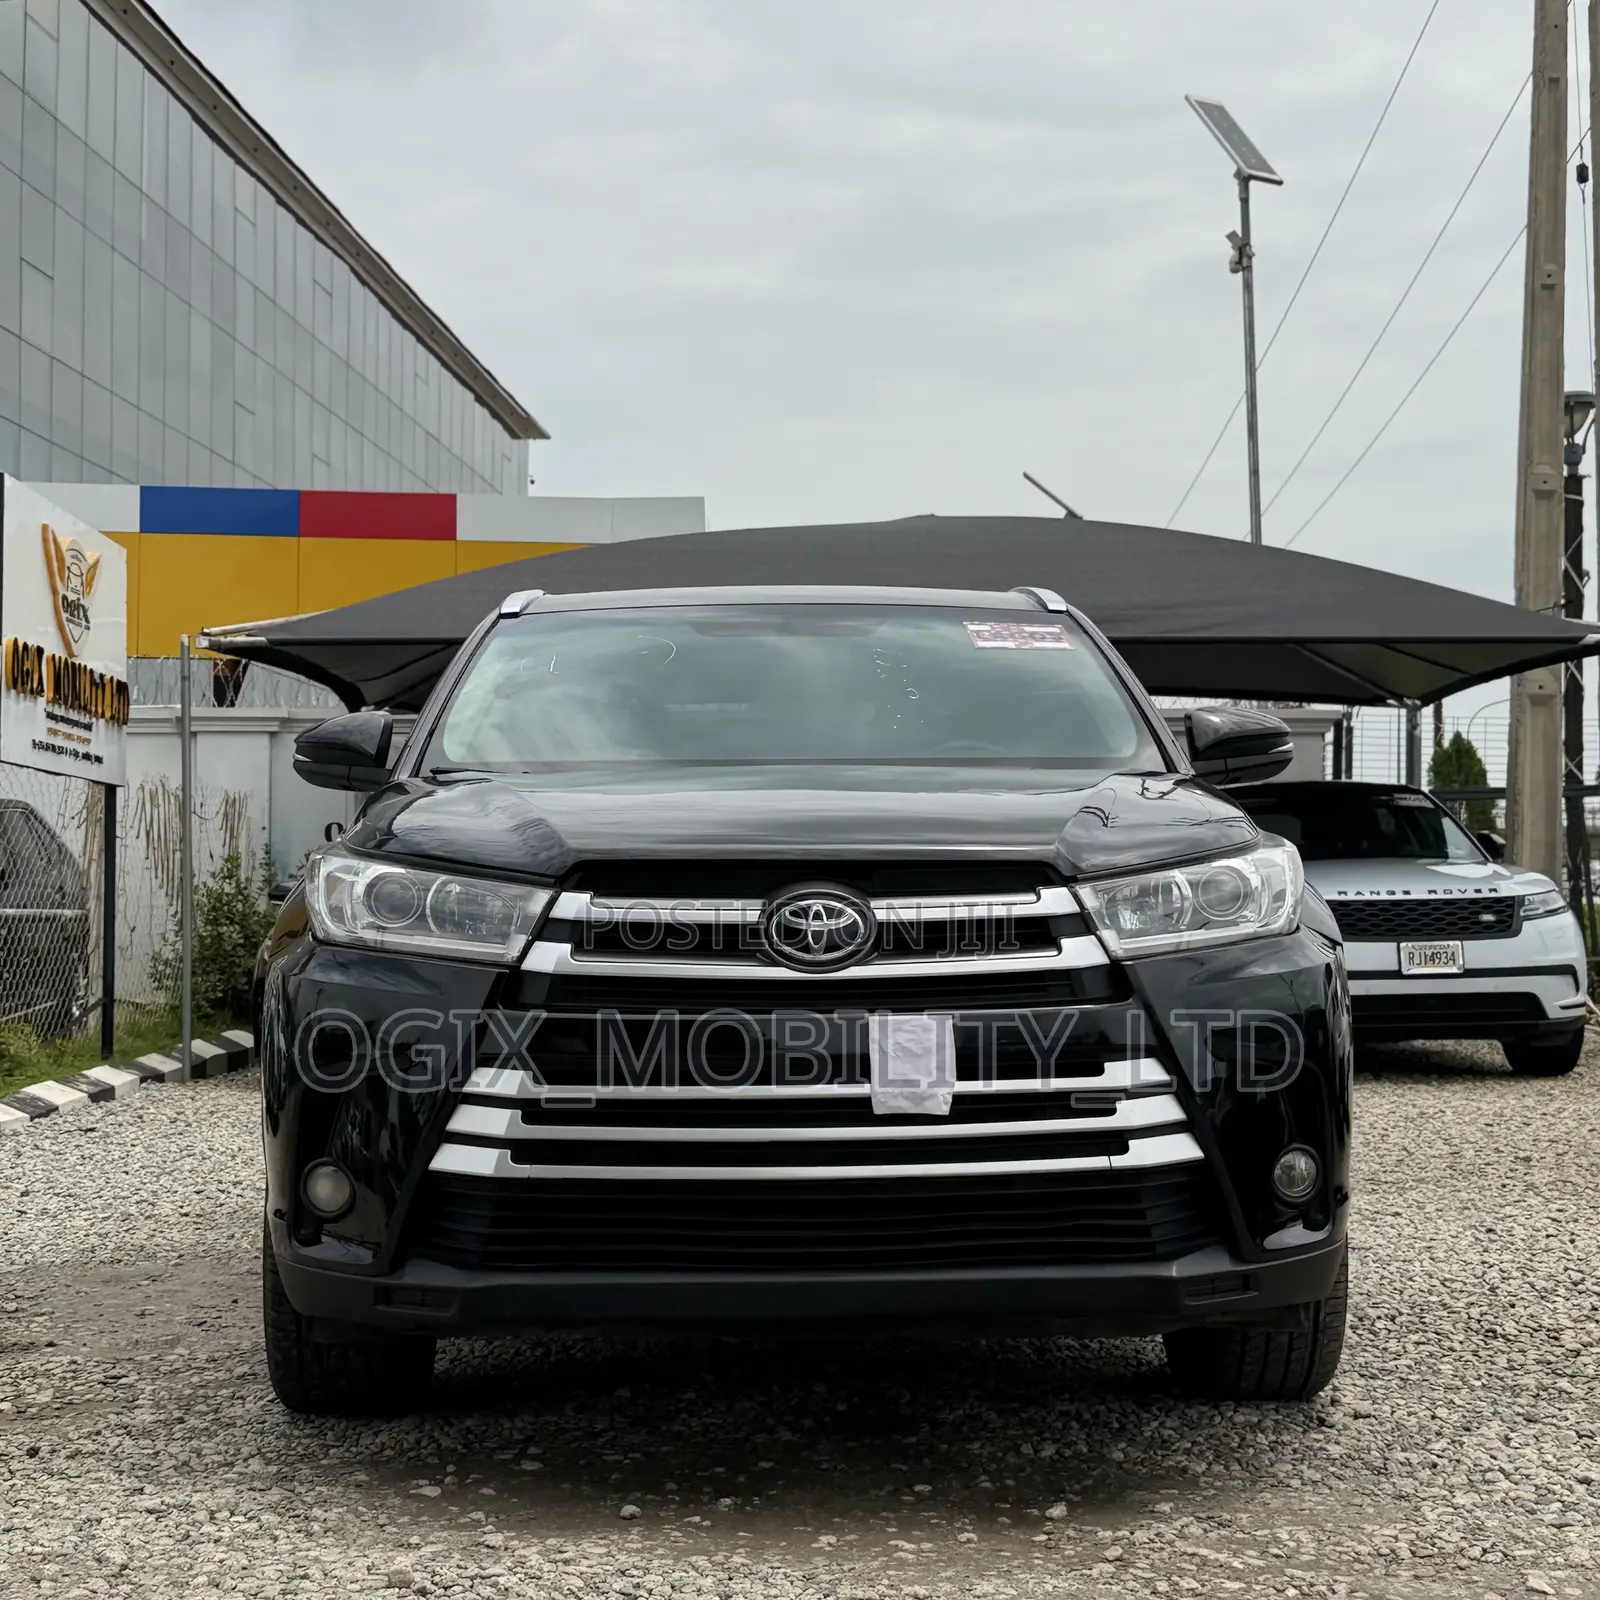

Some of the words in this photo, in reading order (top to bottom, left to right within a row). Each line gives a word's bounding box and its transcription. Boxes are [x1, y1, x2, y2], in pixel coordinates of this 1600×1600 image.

[6, 637, 45, 698] OGIX
[1337, 889, 1412, 897] RANGE
[1427, 887, 1499, 896] ROVER
